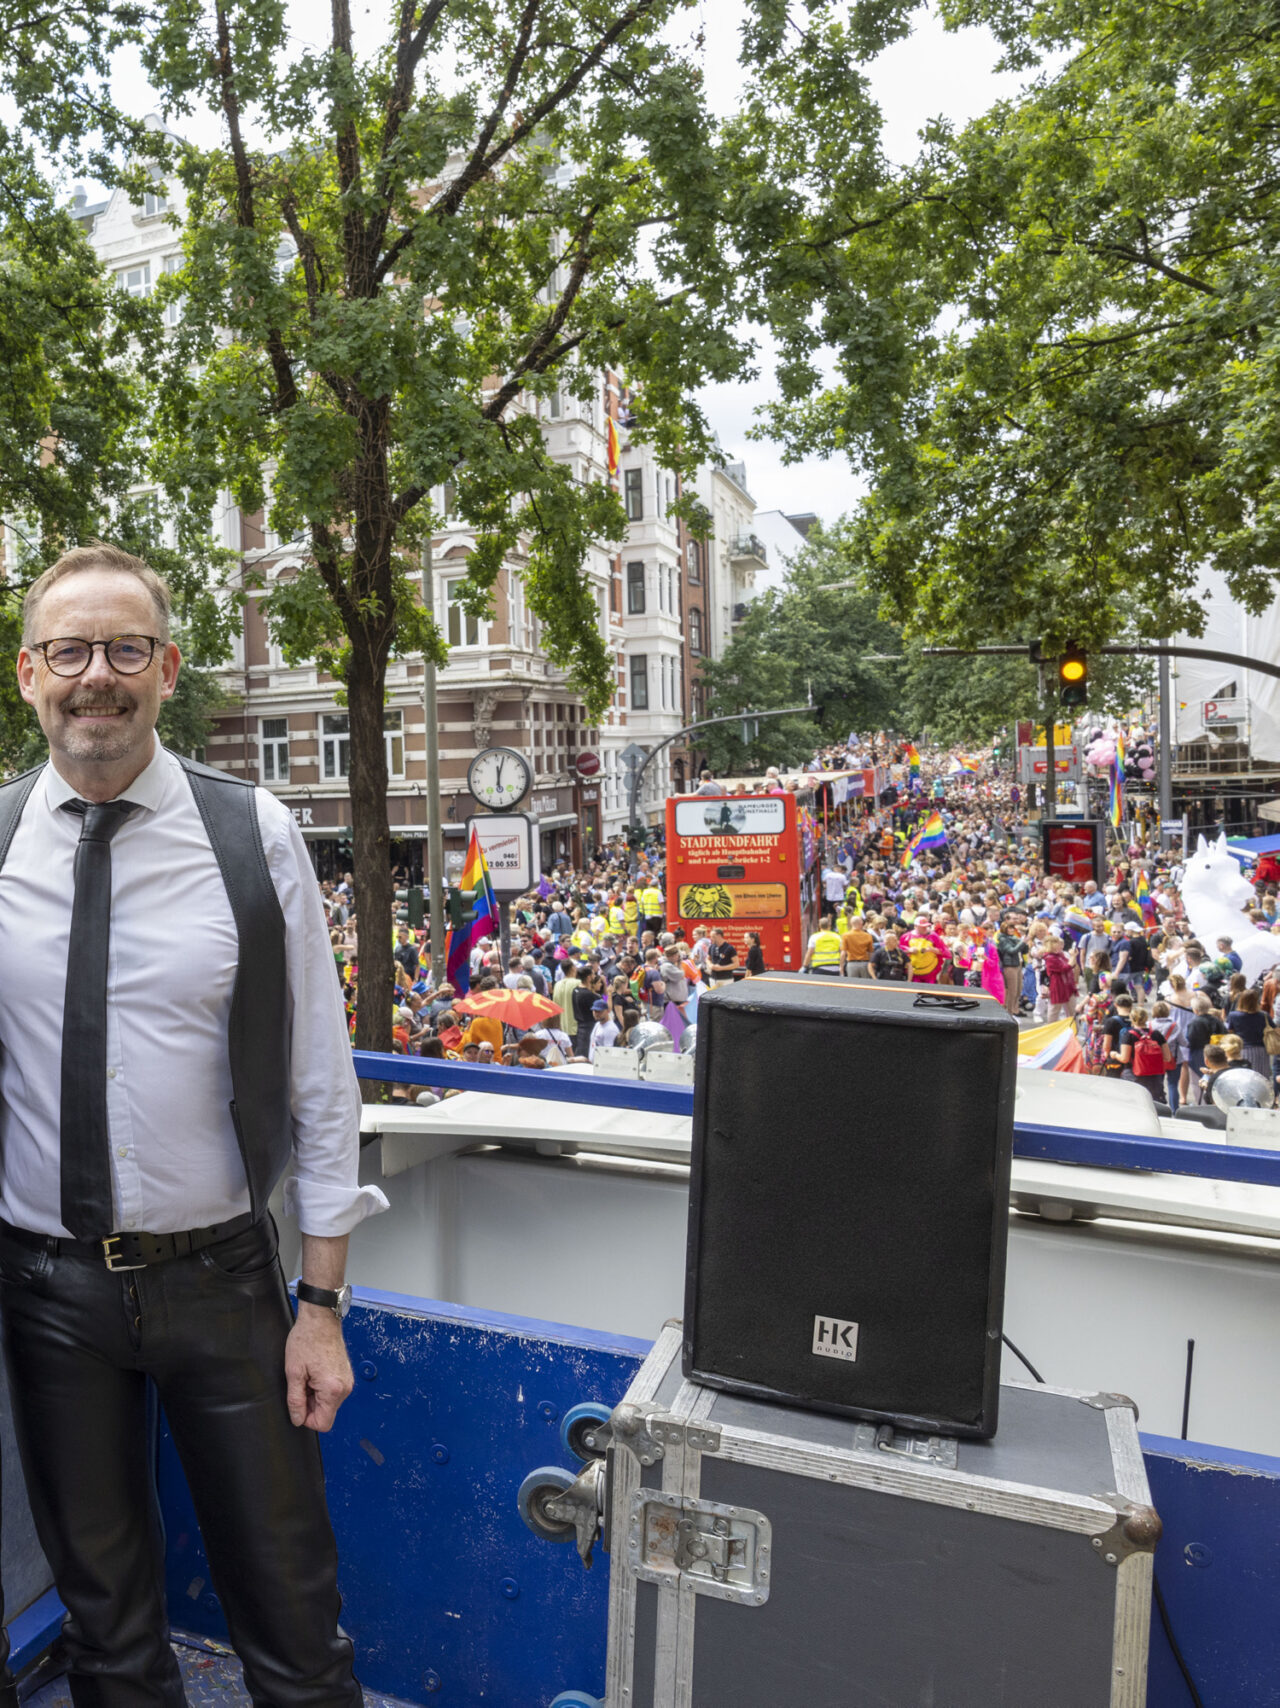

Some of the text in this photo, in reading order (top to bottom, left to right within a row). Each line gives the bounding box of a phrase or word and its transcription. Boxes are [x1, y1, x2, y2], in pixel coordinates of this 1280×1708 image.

[292, 807, 314, 824] ER
[680, 835, 779, 848] STADTRUNDFAHRT
[495, 860, 505, 868] 00
[506, 860, 518, 868] 555
[818, 1321, 853, 1348] HK
[817, 1346, 852, 1356] AUDIO
